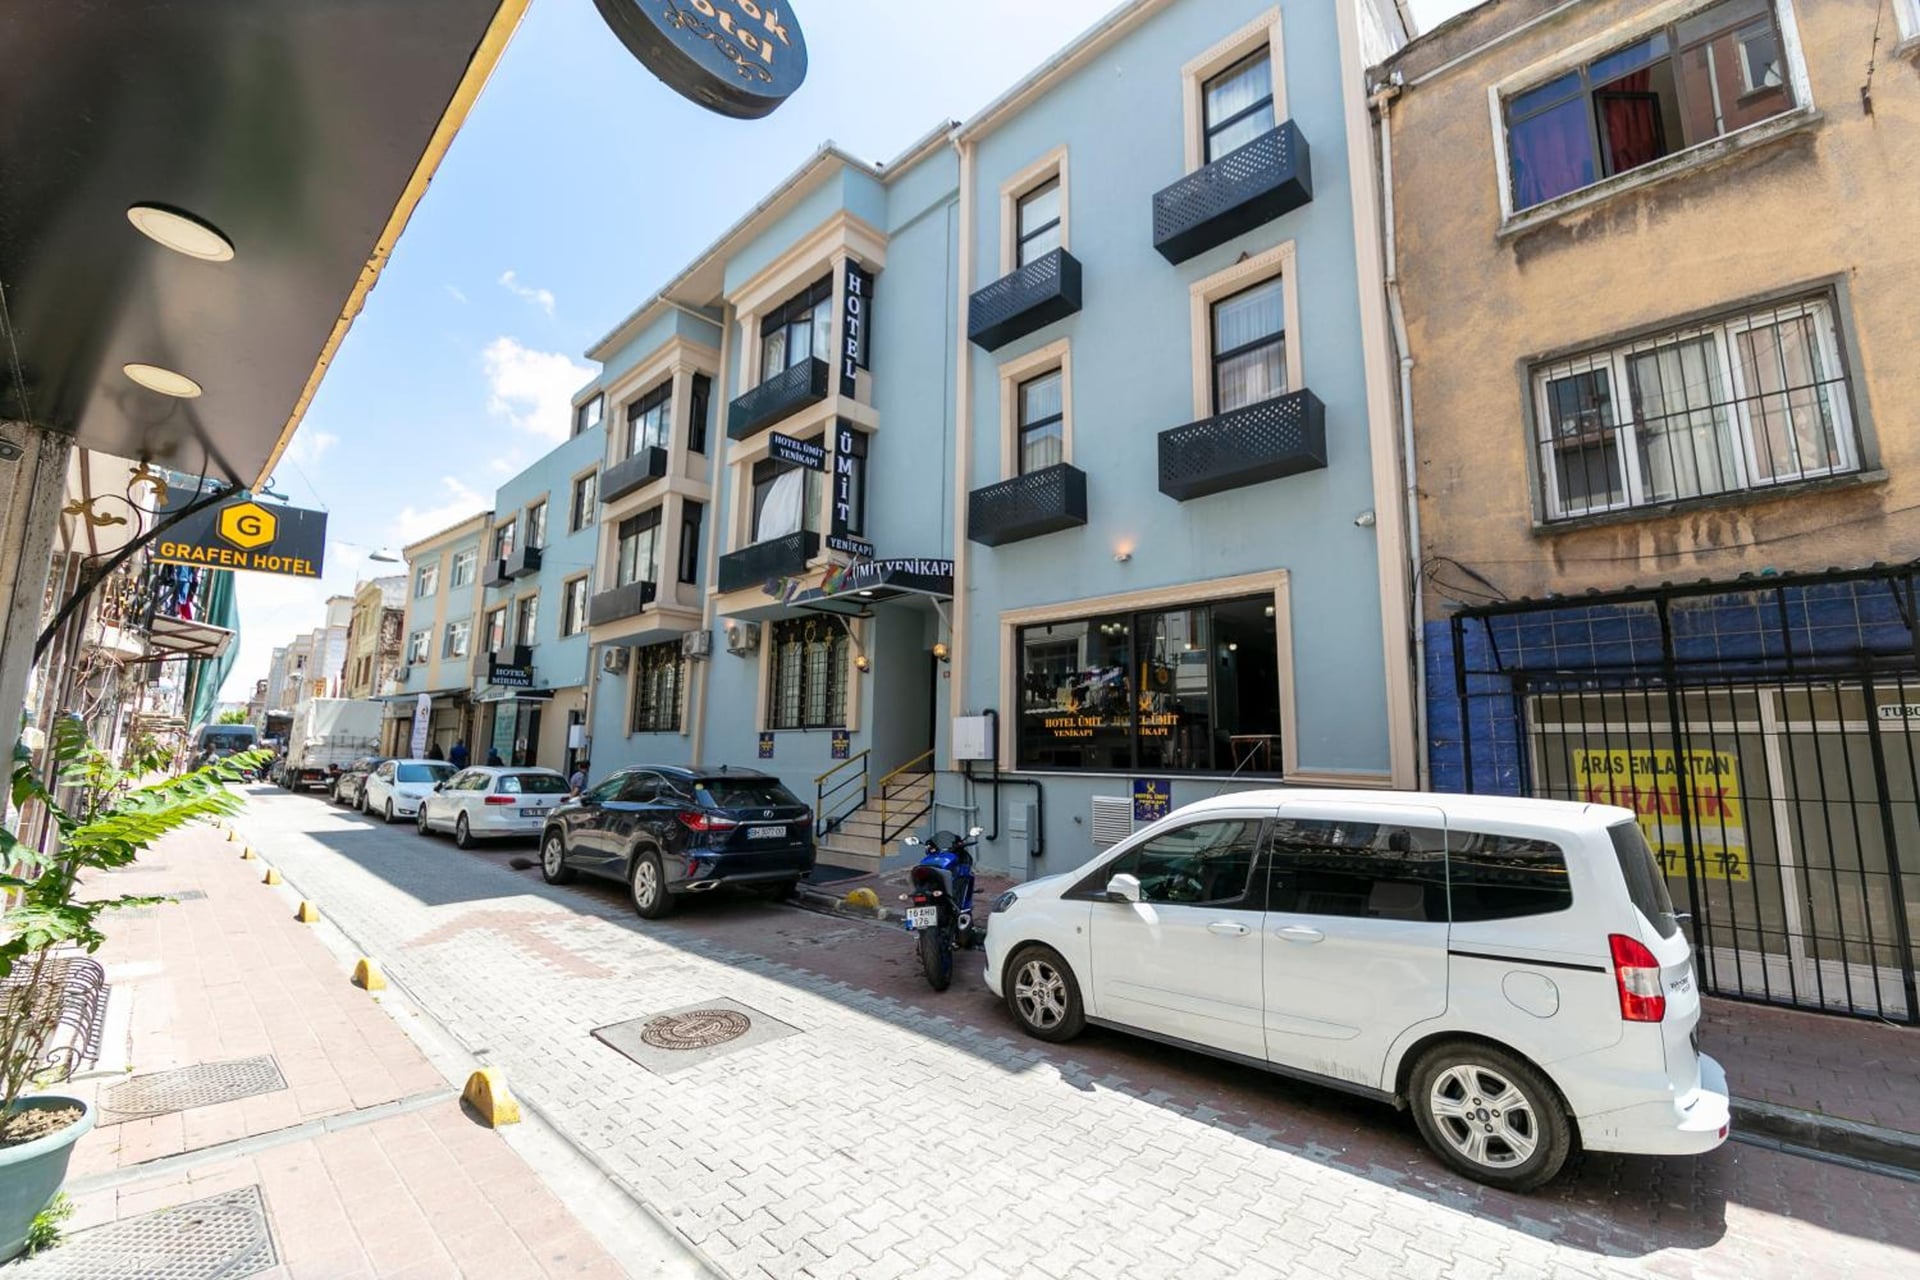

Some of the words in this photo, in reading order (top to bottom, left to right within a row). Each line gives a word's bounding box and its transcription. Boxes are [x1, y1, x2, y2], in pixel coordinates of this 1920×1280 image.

[733, 0, 791, 46] ok
[846, 272, 862, 379] HOTEL
[775, 434, 801, 451] HOTEL
[803, 442, 824, 457] ÜMİT
[780, 448, 818, 467] YENİKAPI
[837, 431, 853, 521] ÜMİT
[236, 515, 262, 537] G
[830, 537, 874, 557] YENİKAPI
[160, 542, 248, 567] GRAFEN
[253, 554, 317, 576] HOTEL
[495, 668, 527, 678] HOTEL
[1045, 717, 1076, 728] HOTEL
[1053, 728, 1094, 737] YENİKAPI
[1580, 756, 1625, 775] ARAS
